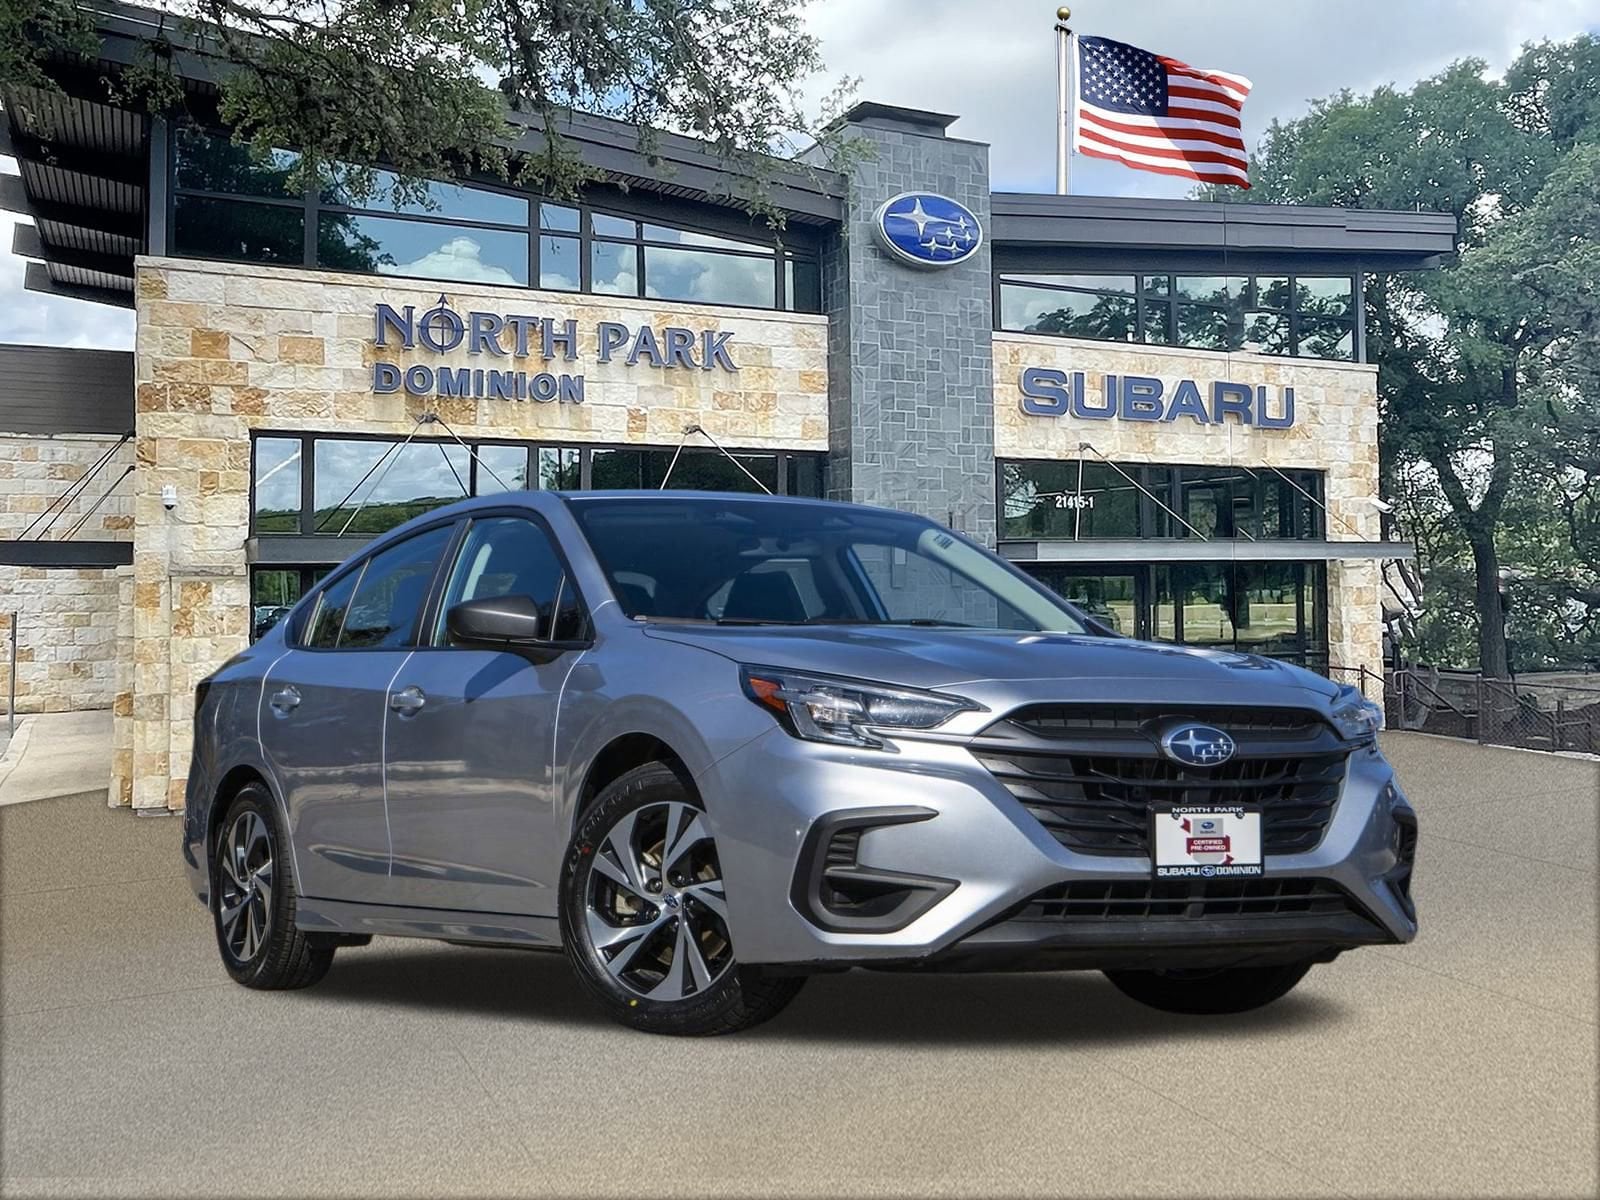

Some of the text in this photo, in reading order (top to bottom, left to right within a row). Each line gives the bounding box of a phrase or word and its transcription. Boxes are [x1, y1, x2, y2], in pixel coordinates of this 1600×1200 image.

[374, 301, 741, 372] NORTH PARK
[372, 361, 585, 404] DOMINION
[1018, 366, 1295, 430] SUBARU
[1157, 866, 1261, 876] SUBARU DOMINION
